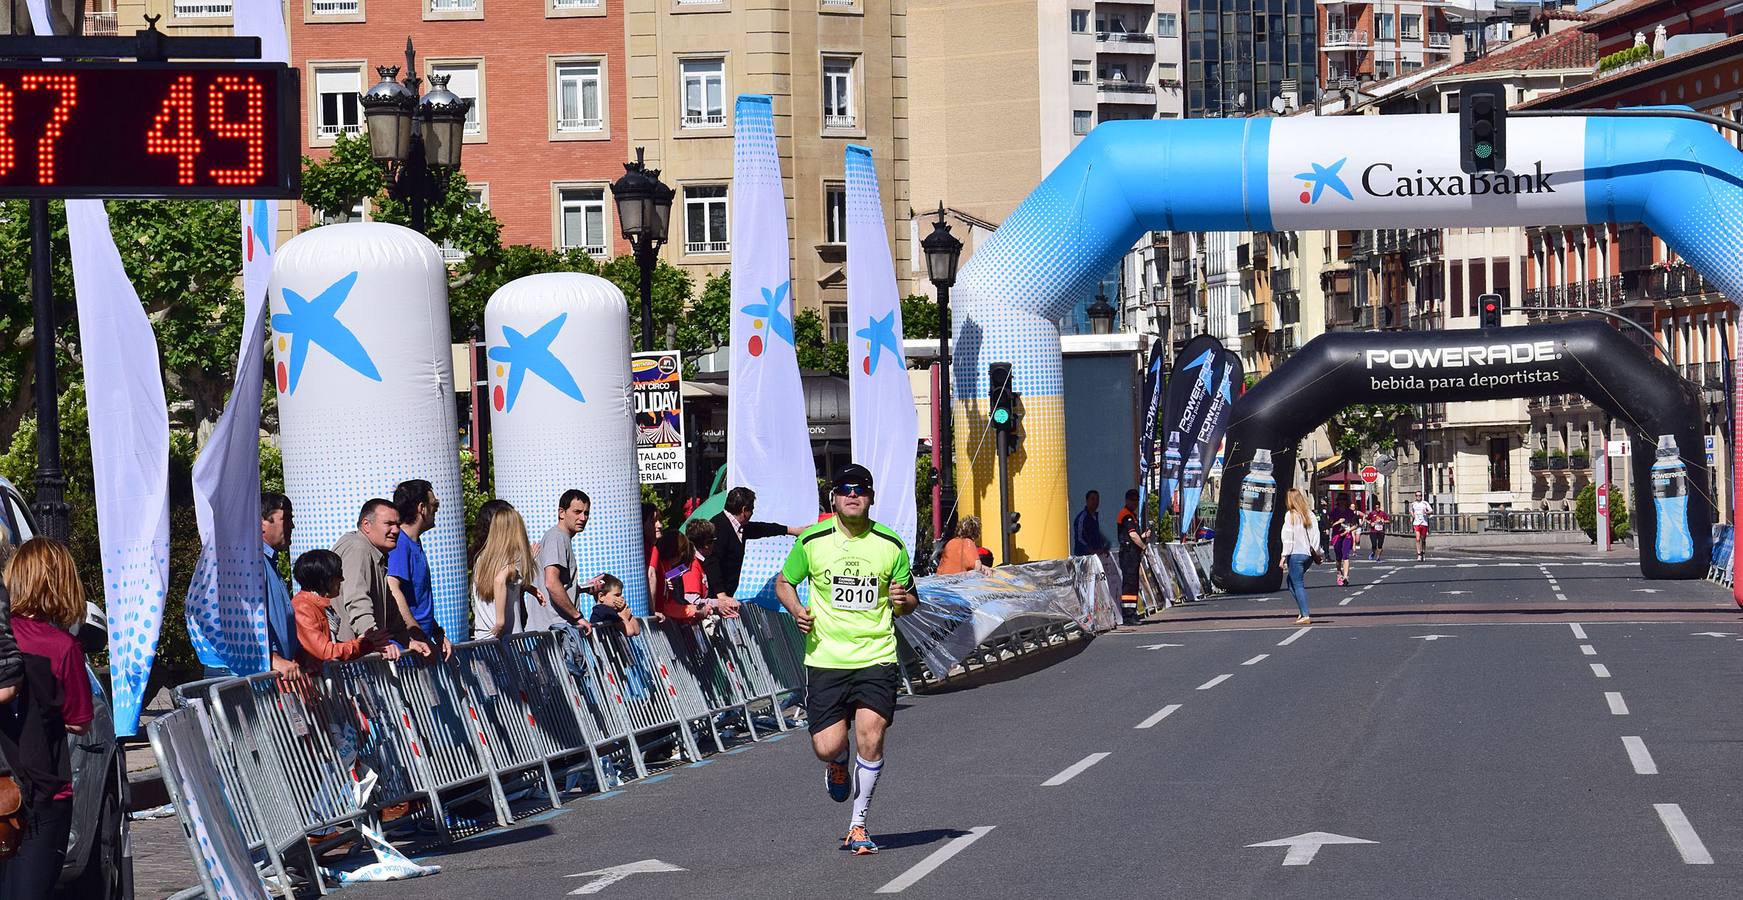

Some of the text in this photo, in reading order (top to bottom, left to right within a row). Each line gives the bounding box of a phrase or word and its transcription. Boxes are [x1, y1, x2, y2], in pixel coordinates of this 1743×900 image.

[0, 75, 264, 185] 7 49
[1361, 160, 1556, 197] CaixaBank
[1366, 341, 1556, 370] POWERADE
[647, 382, 670, 391] CIRCO
[1178, 351, 1216, 431] POWERADE
[1371, 370, 1560, 391] bebida para deportistas
[633, 391, 678, 414] OLIDAY
[638, 452, 677, 461] TALADO
[645, 462, 684, 471] RECINTO
[834, 587, 875, 604] 2010
